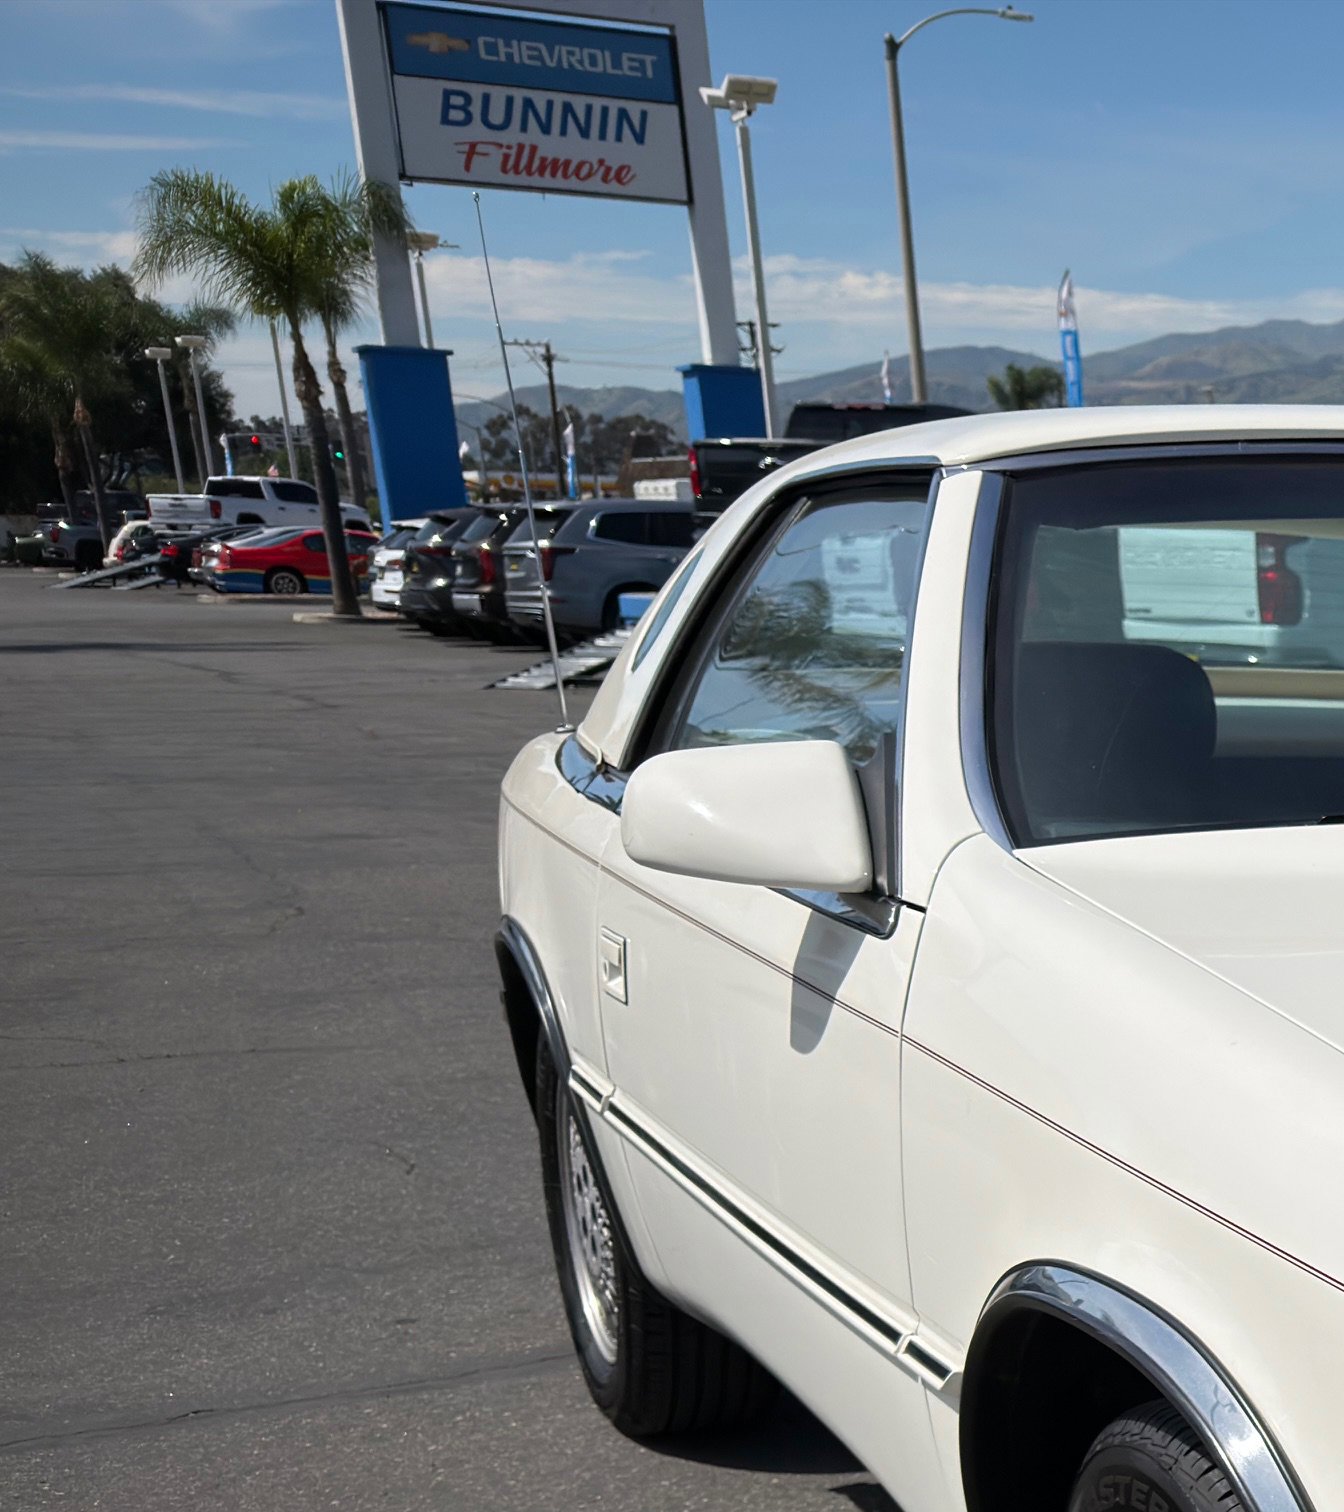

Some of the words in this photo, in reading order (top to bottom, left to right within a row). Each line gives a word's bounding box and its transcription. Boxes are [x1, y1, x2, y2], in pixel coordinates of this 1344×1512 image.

[477, 36, 658, 79] CHEVROLET
[439, 88, 648, 146] BUNNIN
[453, 140, 637, 186] Fillmore
